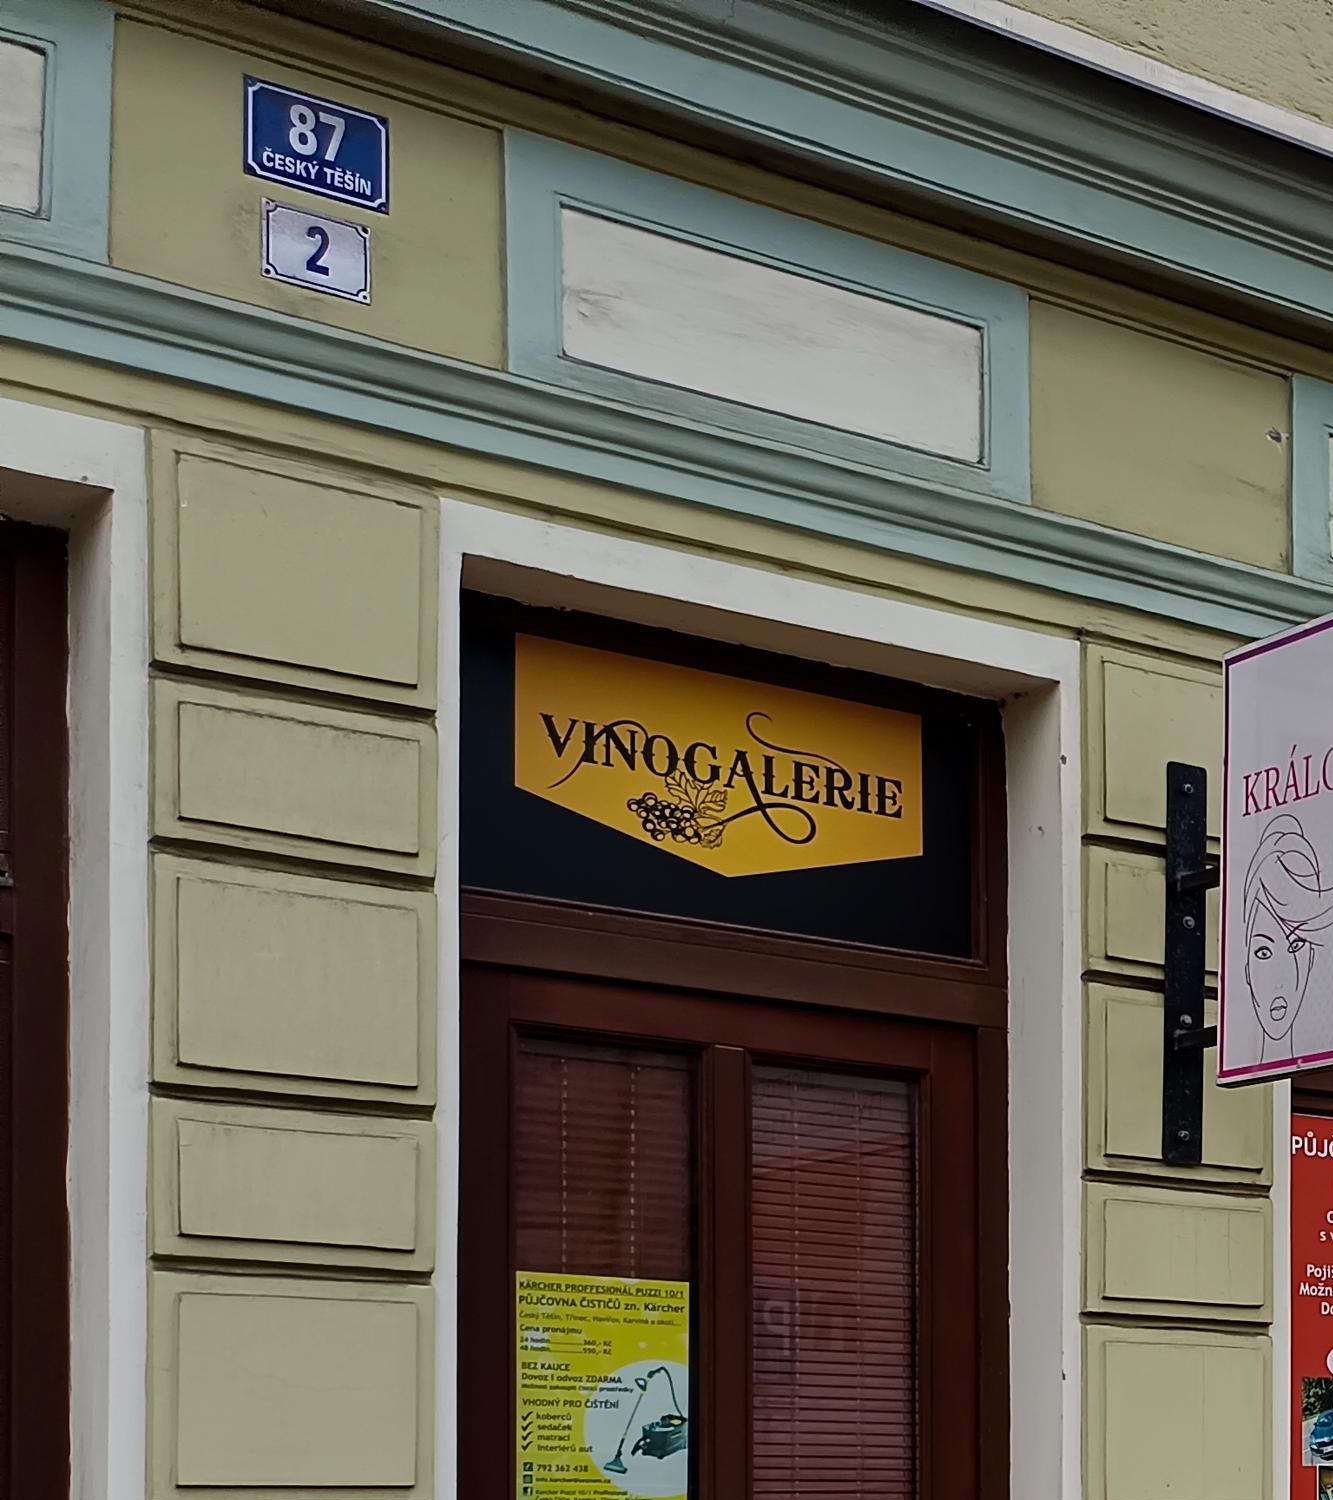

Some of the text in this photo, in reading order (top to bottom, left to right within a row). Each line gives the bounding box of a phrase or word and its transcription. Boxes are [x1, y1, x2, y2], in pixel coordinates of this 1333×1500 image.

[289, 104, 346, 161] 87
[263, 147, 371, 196] ČESKÝ TĚŠÍN
[306, 226, 329, 276] 2
[538, 712, 902, 836] VINOGALERIE
[1320, 1231, 1326, 1241] s
[519, 1294, 576, 1307] PŮJČOVNA
[636, 1288, 661, 1296] PUZZI
